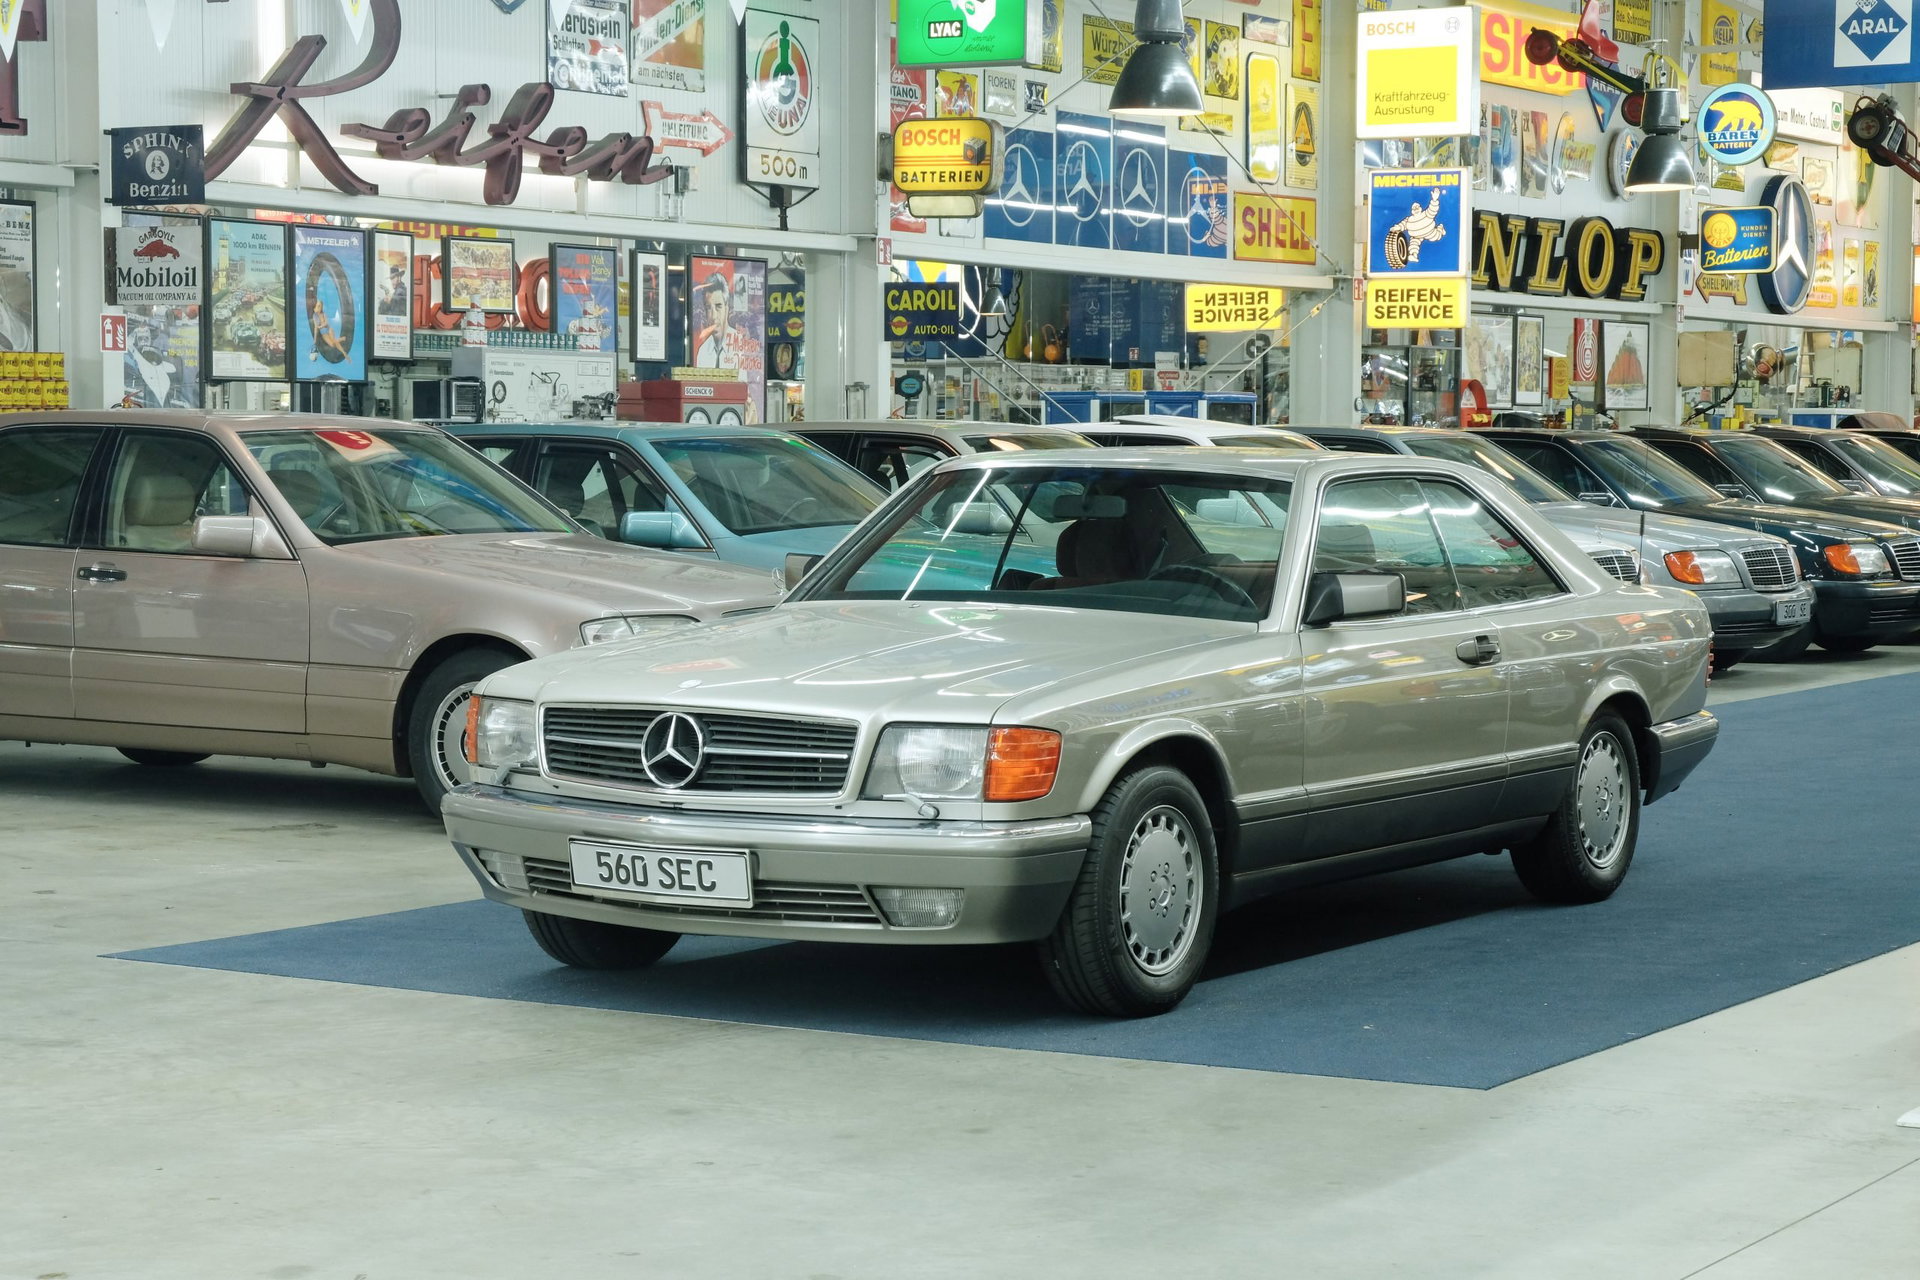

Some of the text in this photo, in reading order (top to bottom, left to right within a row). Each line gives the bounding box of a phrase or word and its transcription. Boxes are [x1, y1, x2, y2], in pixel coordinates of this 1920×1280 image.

[561, 12, 621, 39] erbstein
[929, 22, 961, 38] LYAC
[1367, 21, 1415, 36] BOSCH
[1848, 17, 1900, 36] ARAL
[1714, 27, 1734, 44] HELLA
[1091, 30, 1137, 57] Würzbur
[638, 66, 685, 81] am nächsten
[890, 86, 919, 99] TANOL
[1374, 90, 1450, 103] Kraftfahrzeug-
[203, 0, 655, 204] Reifen
[901, 128, 961, 147] BOSCH
[1714, 141, 1753, 149] BATTERIE
[760, 154, 808, 179] 500 m
[900, 169, 983, 183] BATTERIEN
[1373, 173, 1459, 188] MICHELIN
[129, 178, 188, 198] Benzin
[1242, 205, 1313, 251] SHELL
[251, 233, 267, 241] ADAC
[307, 237, 350, 247] METZELER
[233, 241, 248, 249] 1000
[258, 243, 281, 251] RENNEN
[1472, 209, 1664, 301] NLOP
[1703, 243, 1769, 268] Batterien
[117, 265, 198, 288] Mobiloil
[1702, 277, 1740, 292] SHELL-PUMPE
[118, 292, 144, 301] VACUUM
[145, 292, 154, 301] OIL
[154, 292, 186, 301] COMPANY
[886, 289, 957, 312] CAROIL
[1375, 288, 1453, 303] REIFEN-
[1374, 305, 1453, 320] SERVICE
[914, 324, 955, 335] AUTO-OIL
[686, 387, 707, 395] SCHENCK
[1783, 603, 1807, 619] 300 SE
[595, 850, 717, 892] 560 SEC
